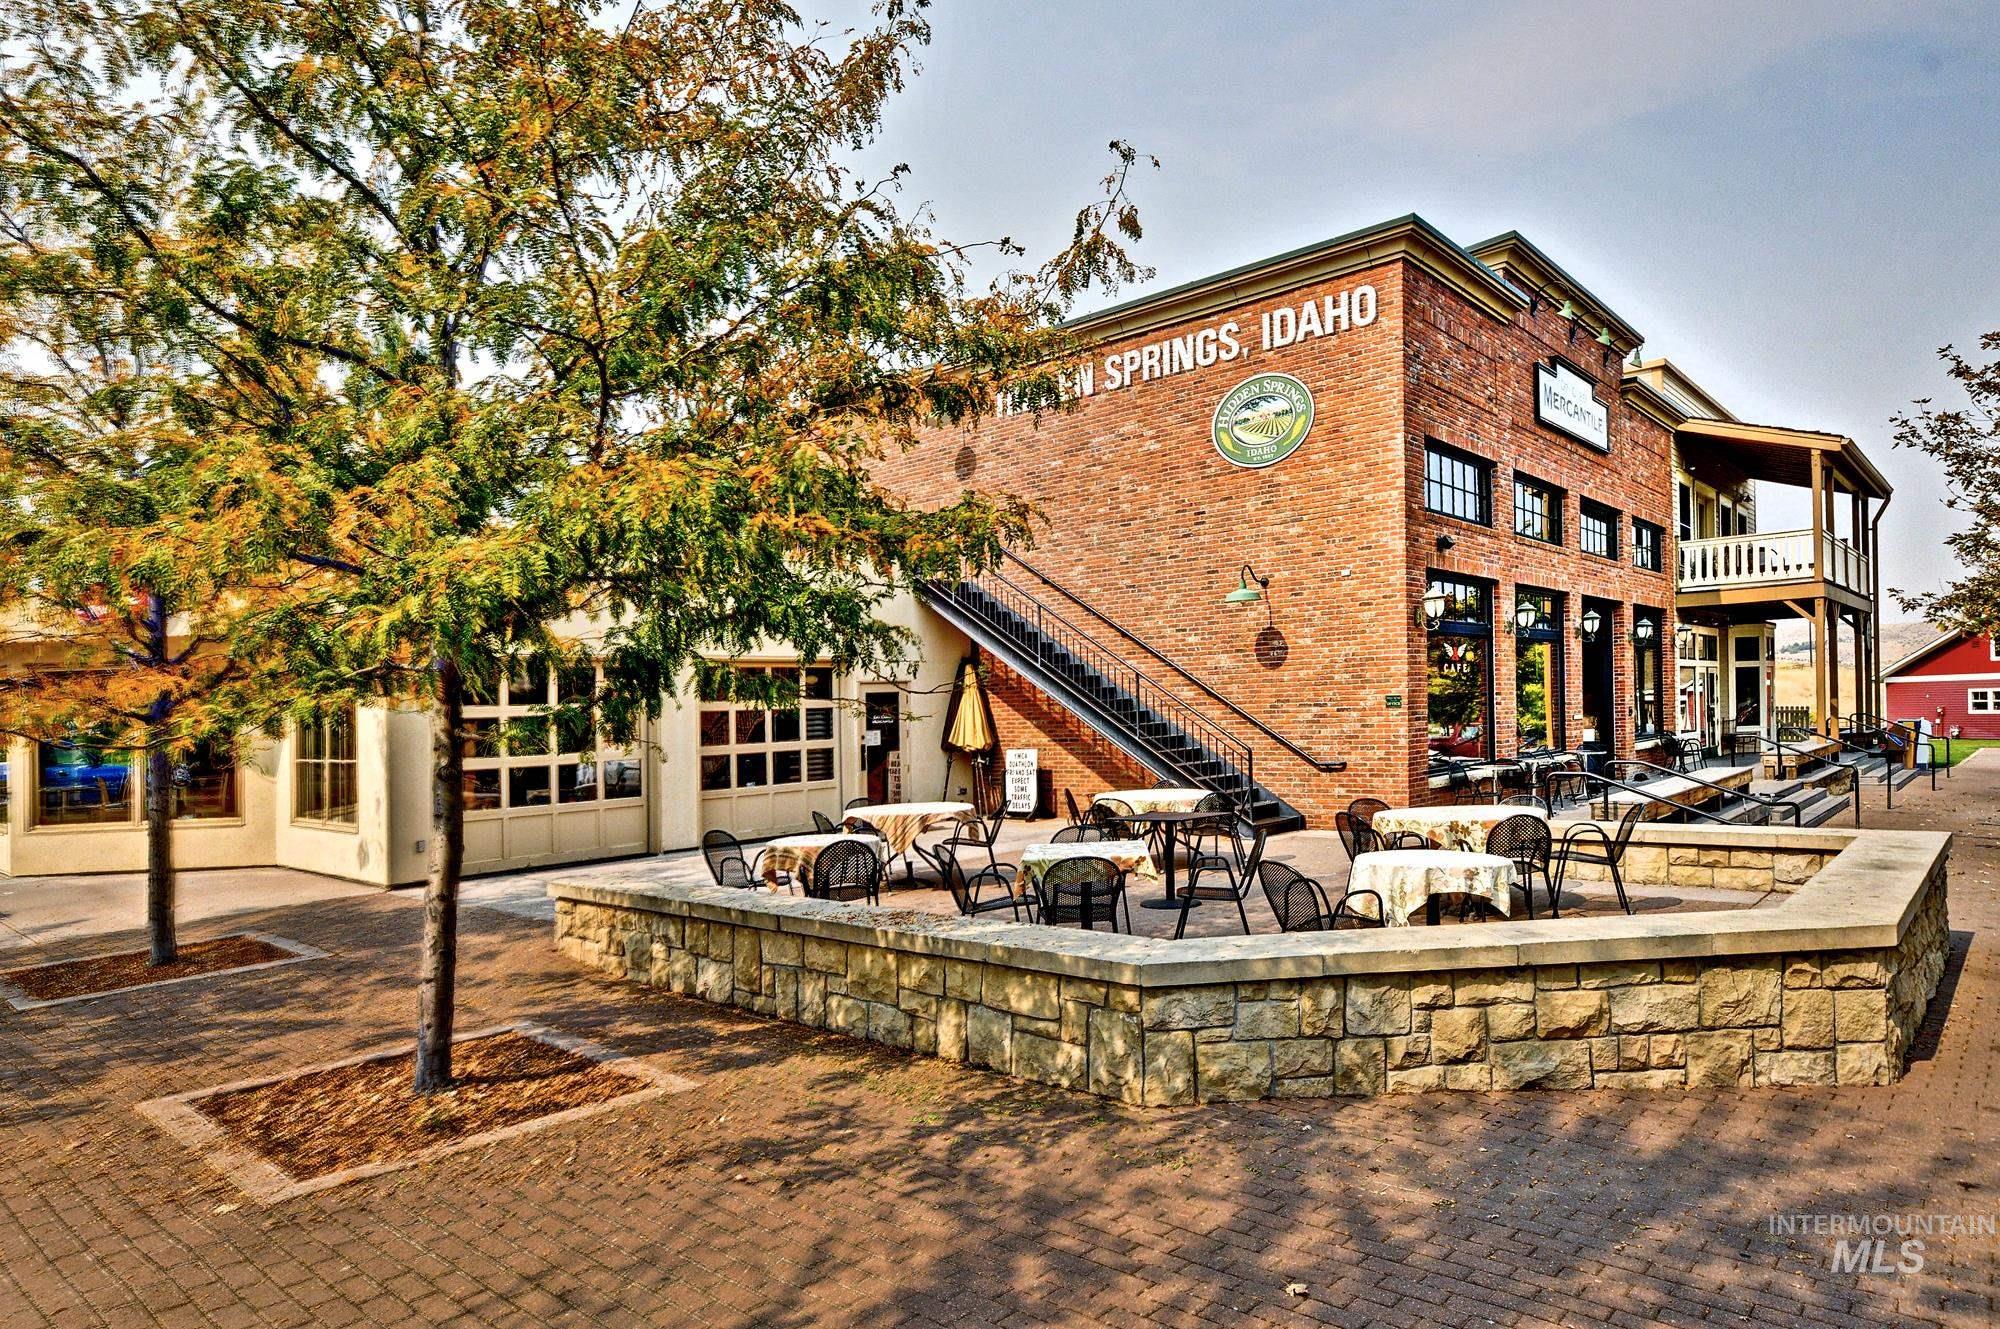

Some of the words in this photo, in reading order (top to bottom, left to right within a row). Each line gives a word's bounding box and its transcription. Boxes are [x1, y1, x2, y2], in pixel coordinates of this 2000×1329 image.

[1103, 322, 1249, 391] SPRINGS,
[1261, 284, 1378, 351] IDAHO
[1217, 384, 1260, 429] HIDDEN
[1263, 380, 1307, 413] SPRINGS
[1543, 383, 1603, 434] MERCANTILE
[1247, 445, 1277, 458] IDAHO
[1443, 663, 1469, 673] CAFE
